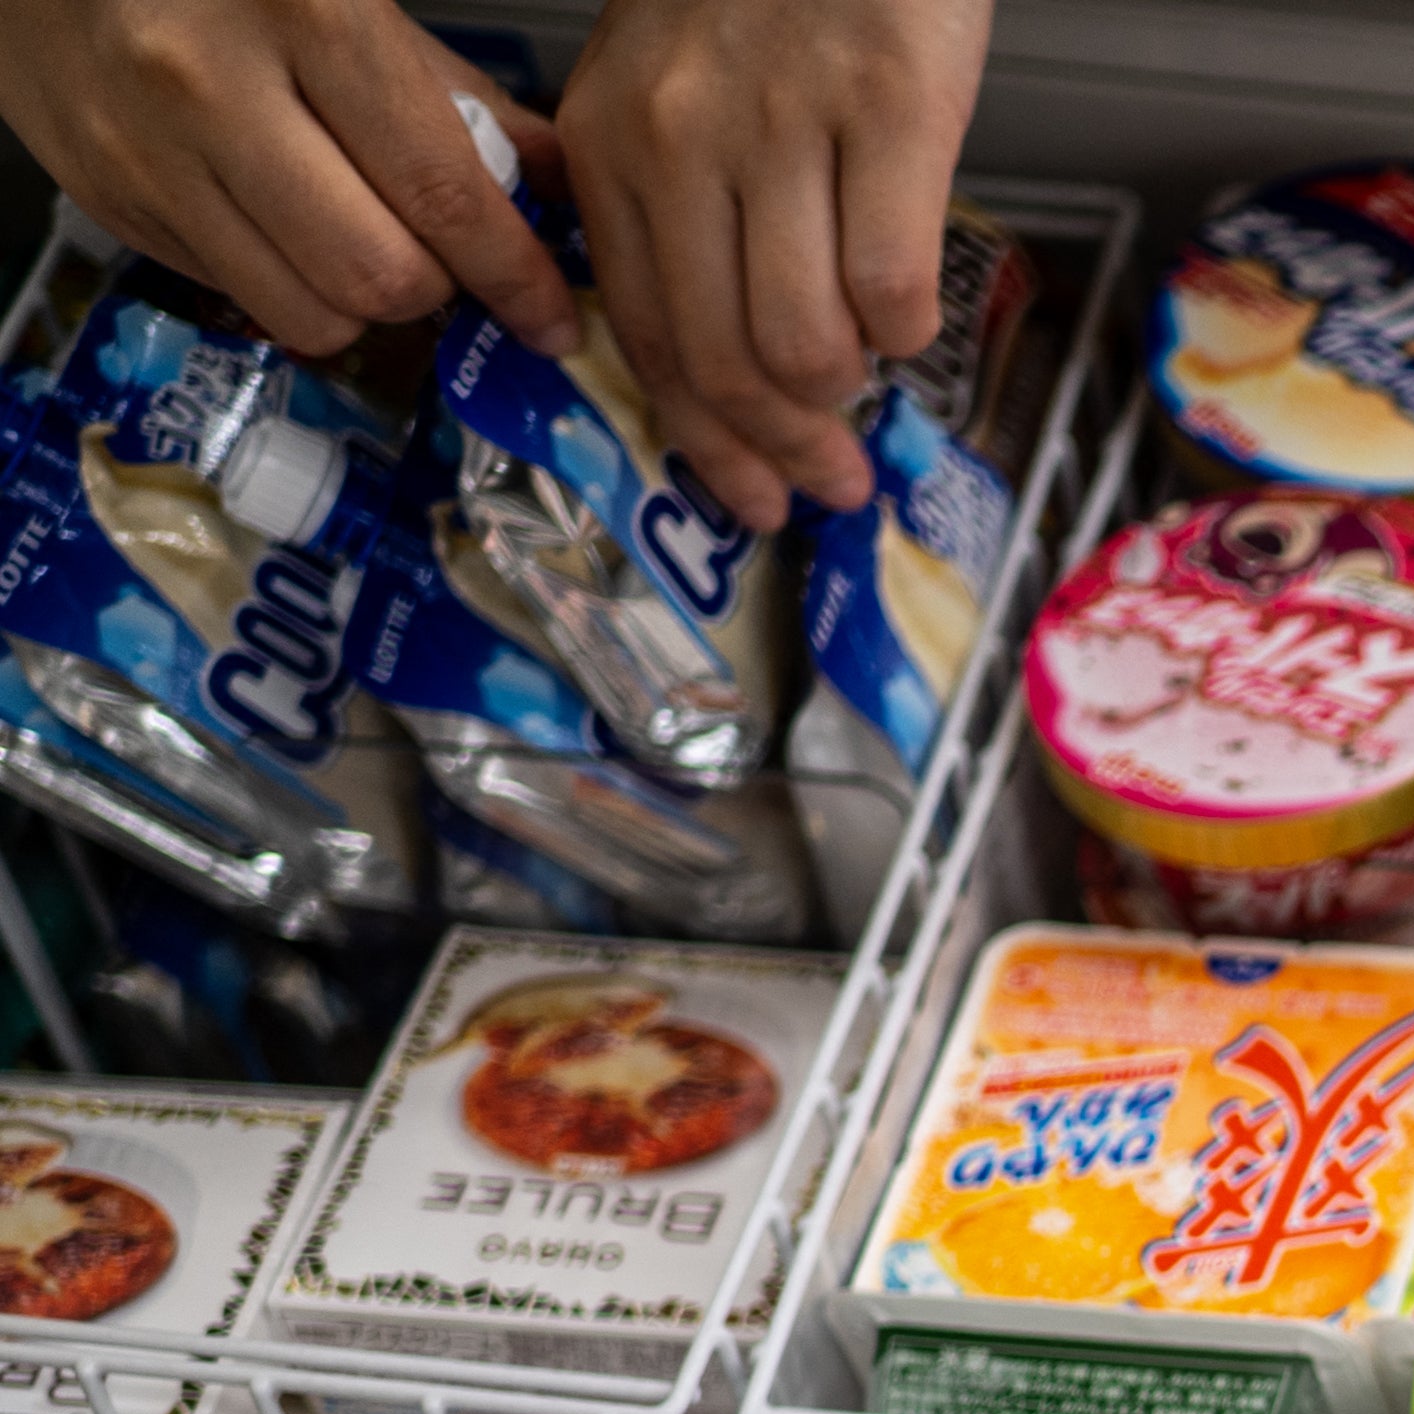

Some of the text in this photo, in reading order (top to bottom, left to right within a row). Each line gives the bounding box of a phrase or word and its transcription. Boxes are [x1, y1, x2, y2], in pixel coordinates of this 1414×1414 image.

[1015, 1084, 1178, 1134] みかん
[946, 1130, 1160, 1193] ひんやり
[421, 1169, 725, 1243] BRULEE
